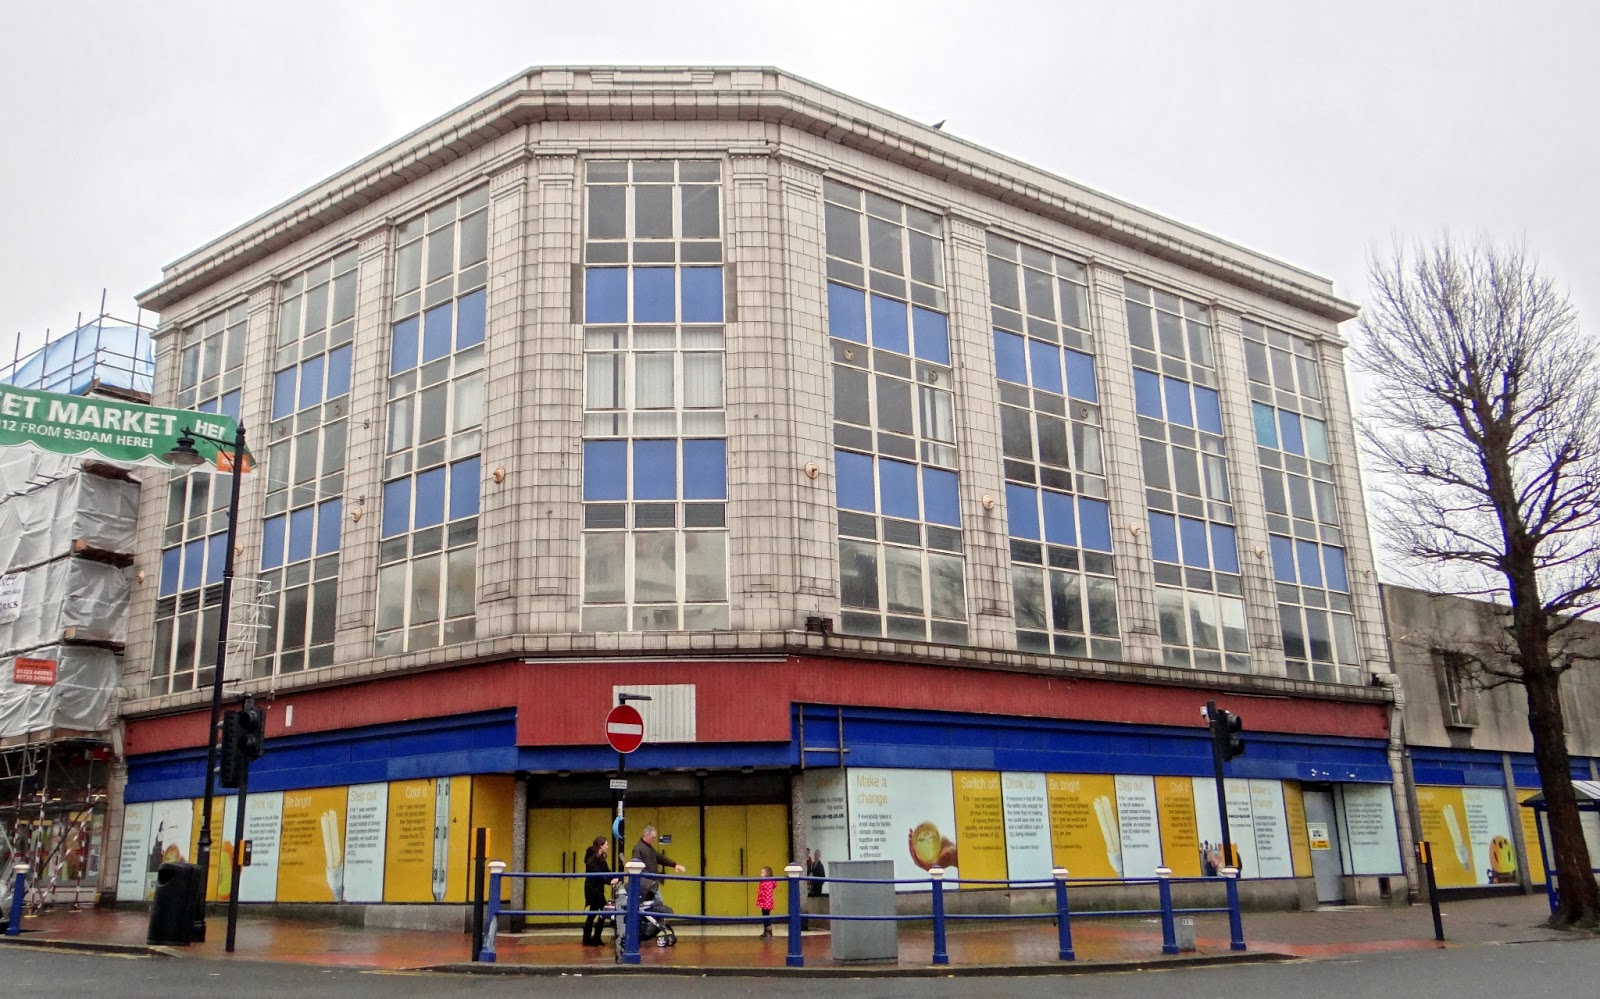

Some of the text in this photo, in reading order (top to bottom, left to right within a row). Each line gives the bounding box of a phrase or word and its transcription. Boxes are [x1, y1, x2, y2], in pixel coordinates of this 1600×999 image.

[0, 391, 177, 436] ET MARKET
[20, 422, 60, 437] FROM
[63, 430, 112, 444] 9:30AM
[116, 435, 153, 448] HERE!
[857, 775, 888, 788] Make a
[961, 777, 998, 789] Switch off
[1005, 778, 1035, 791] Drink up
[405, 786, 421, 798] Cool
[857, 793, 888, 806] change
